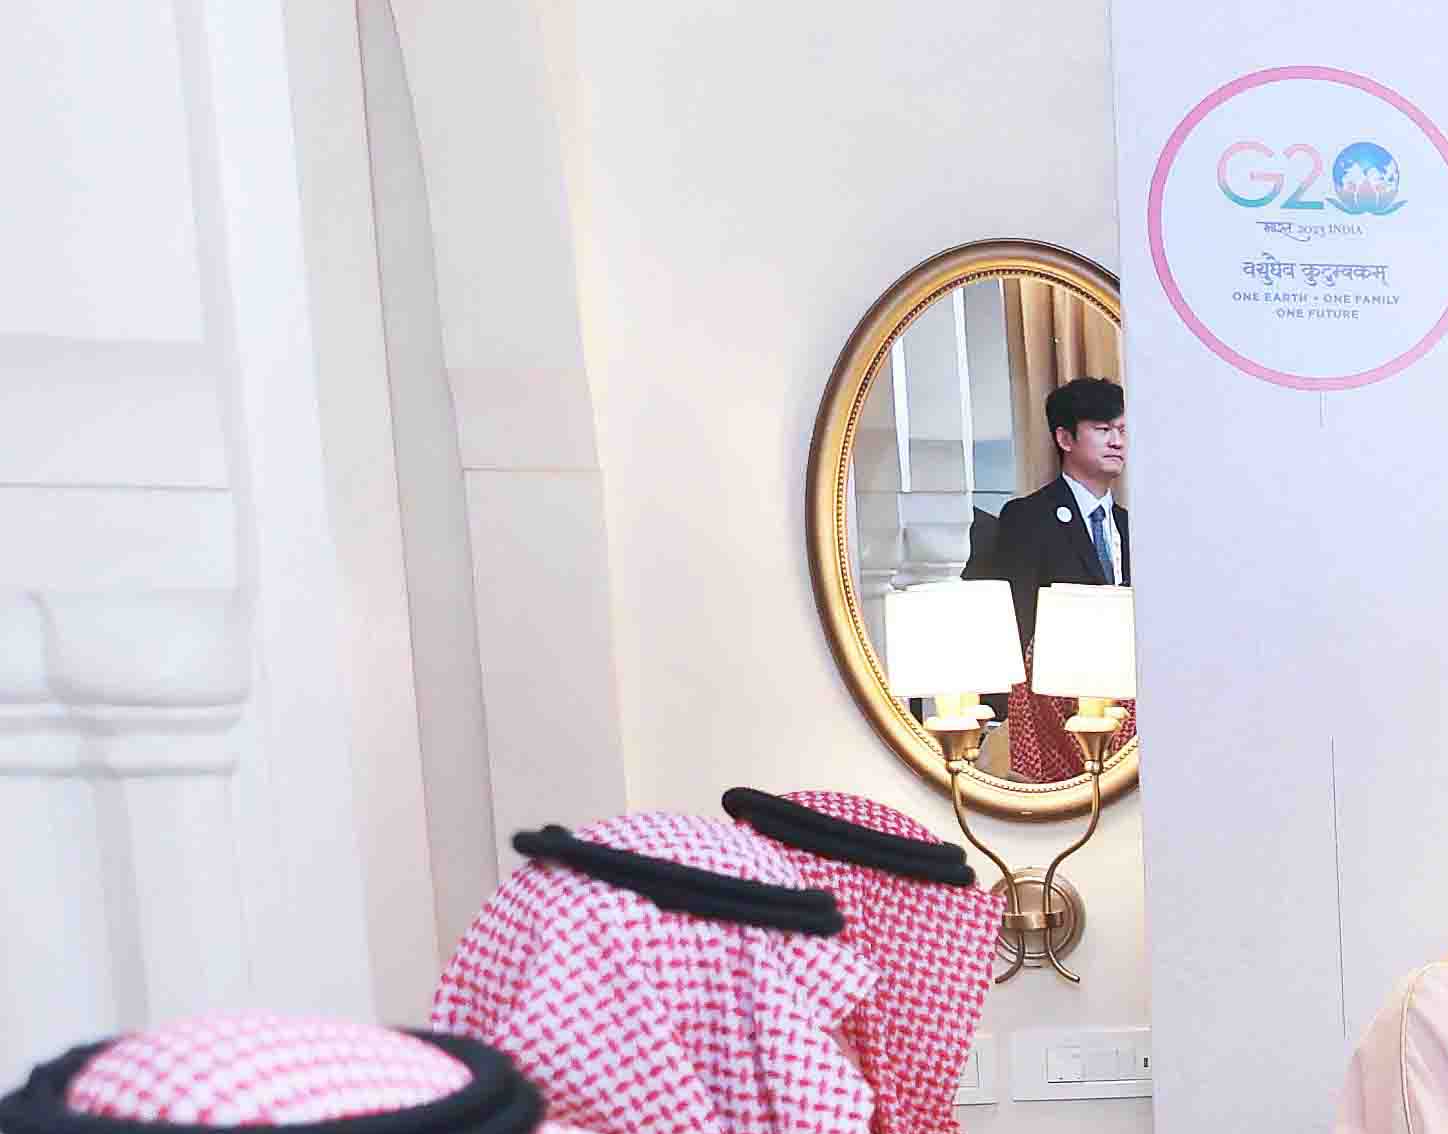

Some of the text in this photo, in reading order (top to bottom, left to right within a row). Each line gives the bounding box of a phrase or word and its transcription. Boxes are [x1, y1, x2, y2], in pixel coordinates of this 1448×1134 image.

[1216, 141, 1409, 216] G20
[1231, 291, 1400, 305] ONE EARTH ONE FAMILY
[1276, 308, 1359, 319] ONE FUTURE
